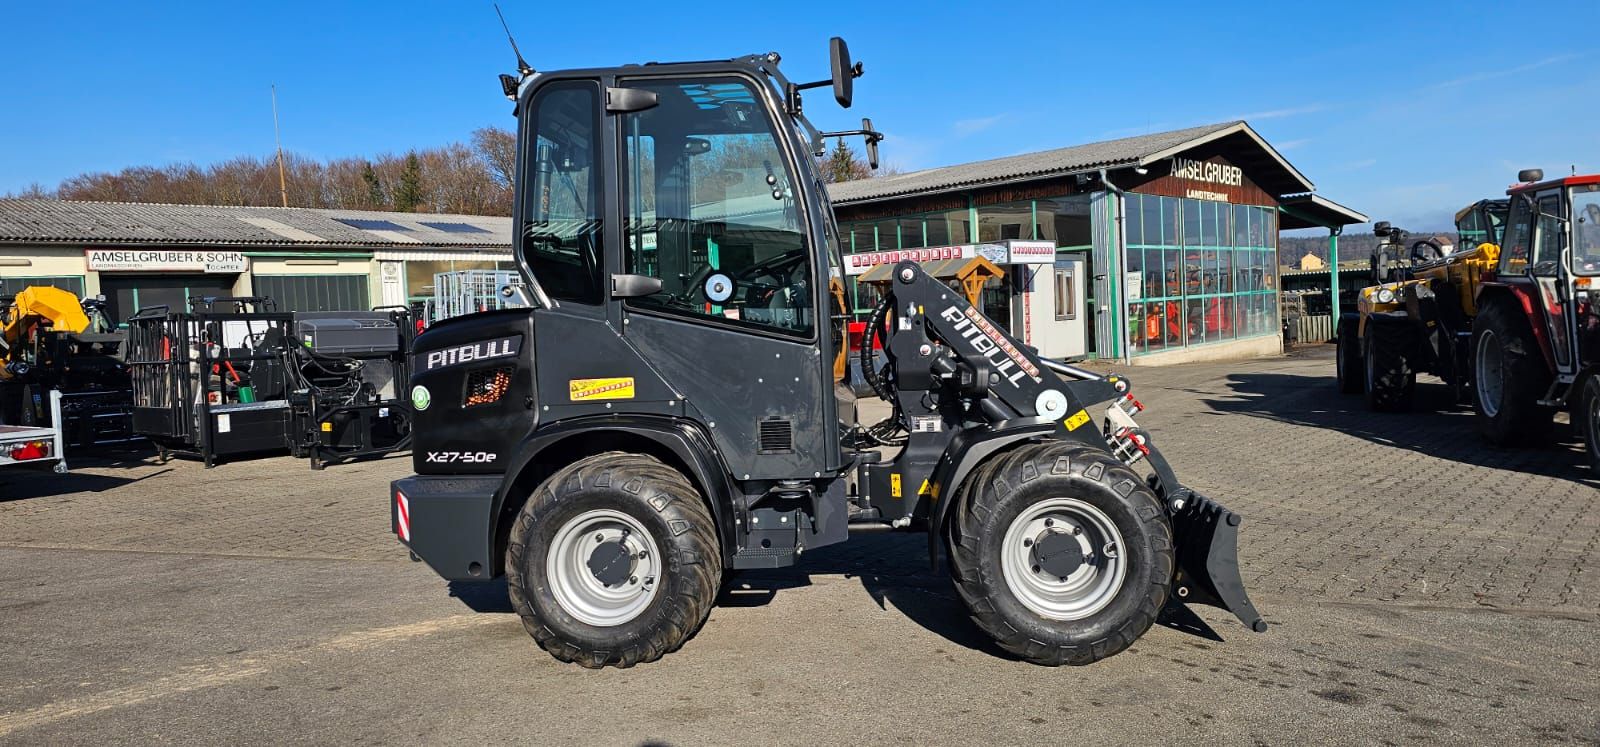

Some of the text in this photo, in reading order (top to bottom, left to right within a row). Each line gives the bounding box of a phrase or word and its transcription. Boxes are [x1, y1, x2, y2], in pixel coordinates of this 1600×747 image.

[1170, 156, 1242, 187] AMSELGRUBER
[1186, 188, 1229, 202] LANDTECHNIK
[92, 252, 243, 262] AMSELGRUBER & SOHN
[852, 246, 962, 267] AMSELGRUBER
[427, 339, 515, 369] PITBULL
[940, 305, 1026, 388] PITBULL
[426, 452, 497, 463] X27-50e
